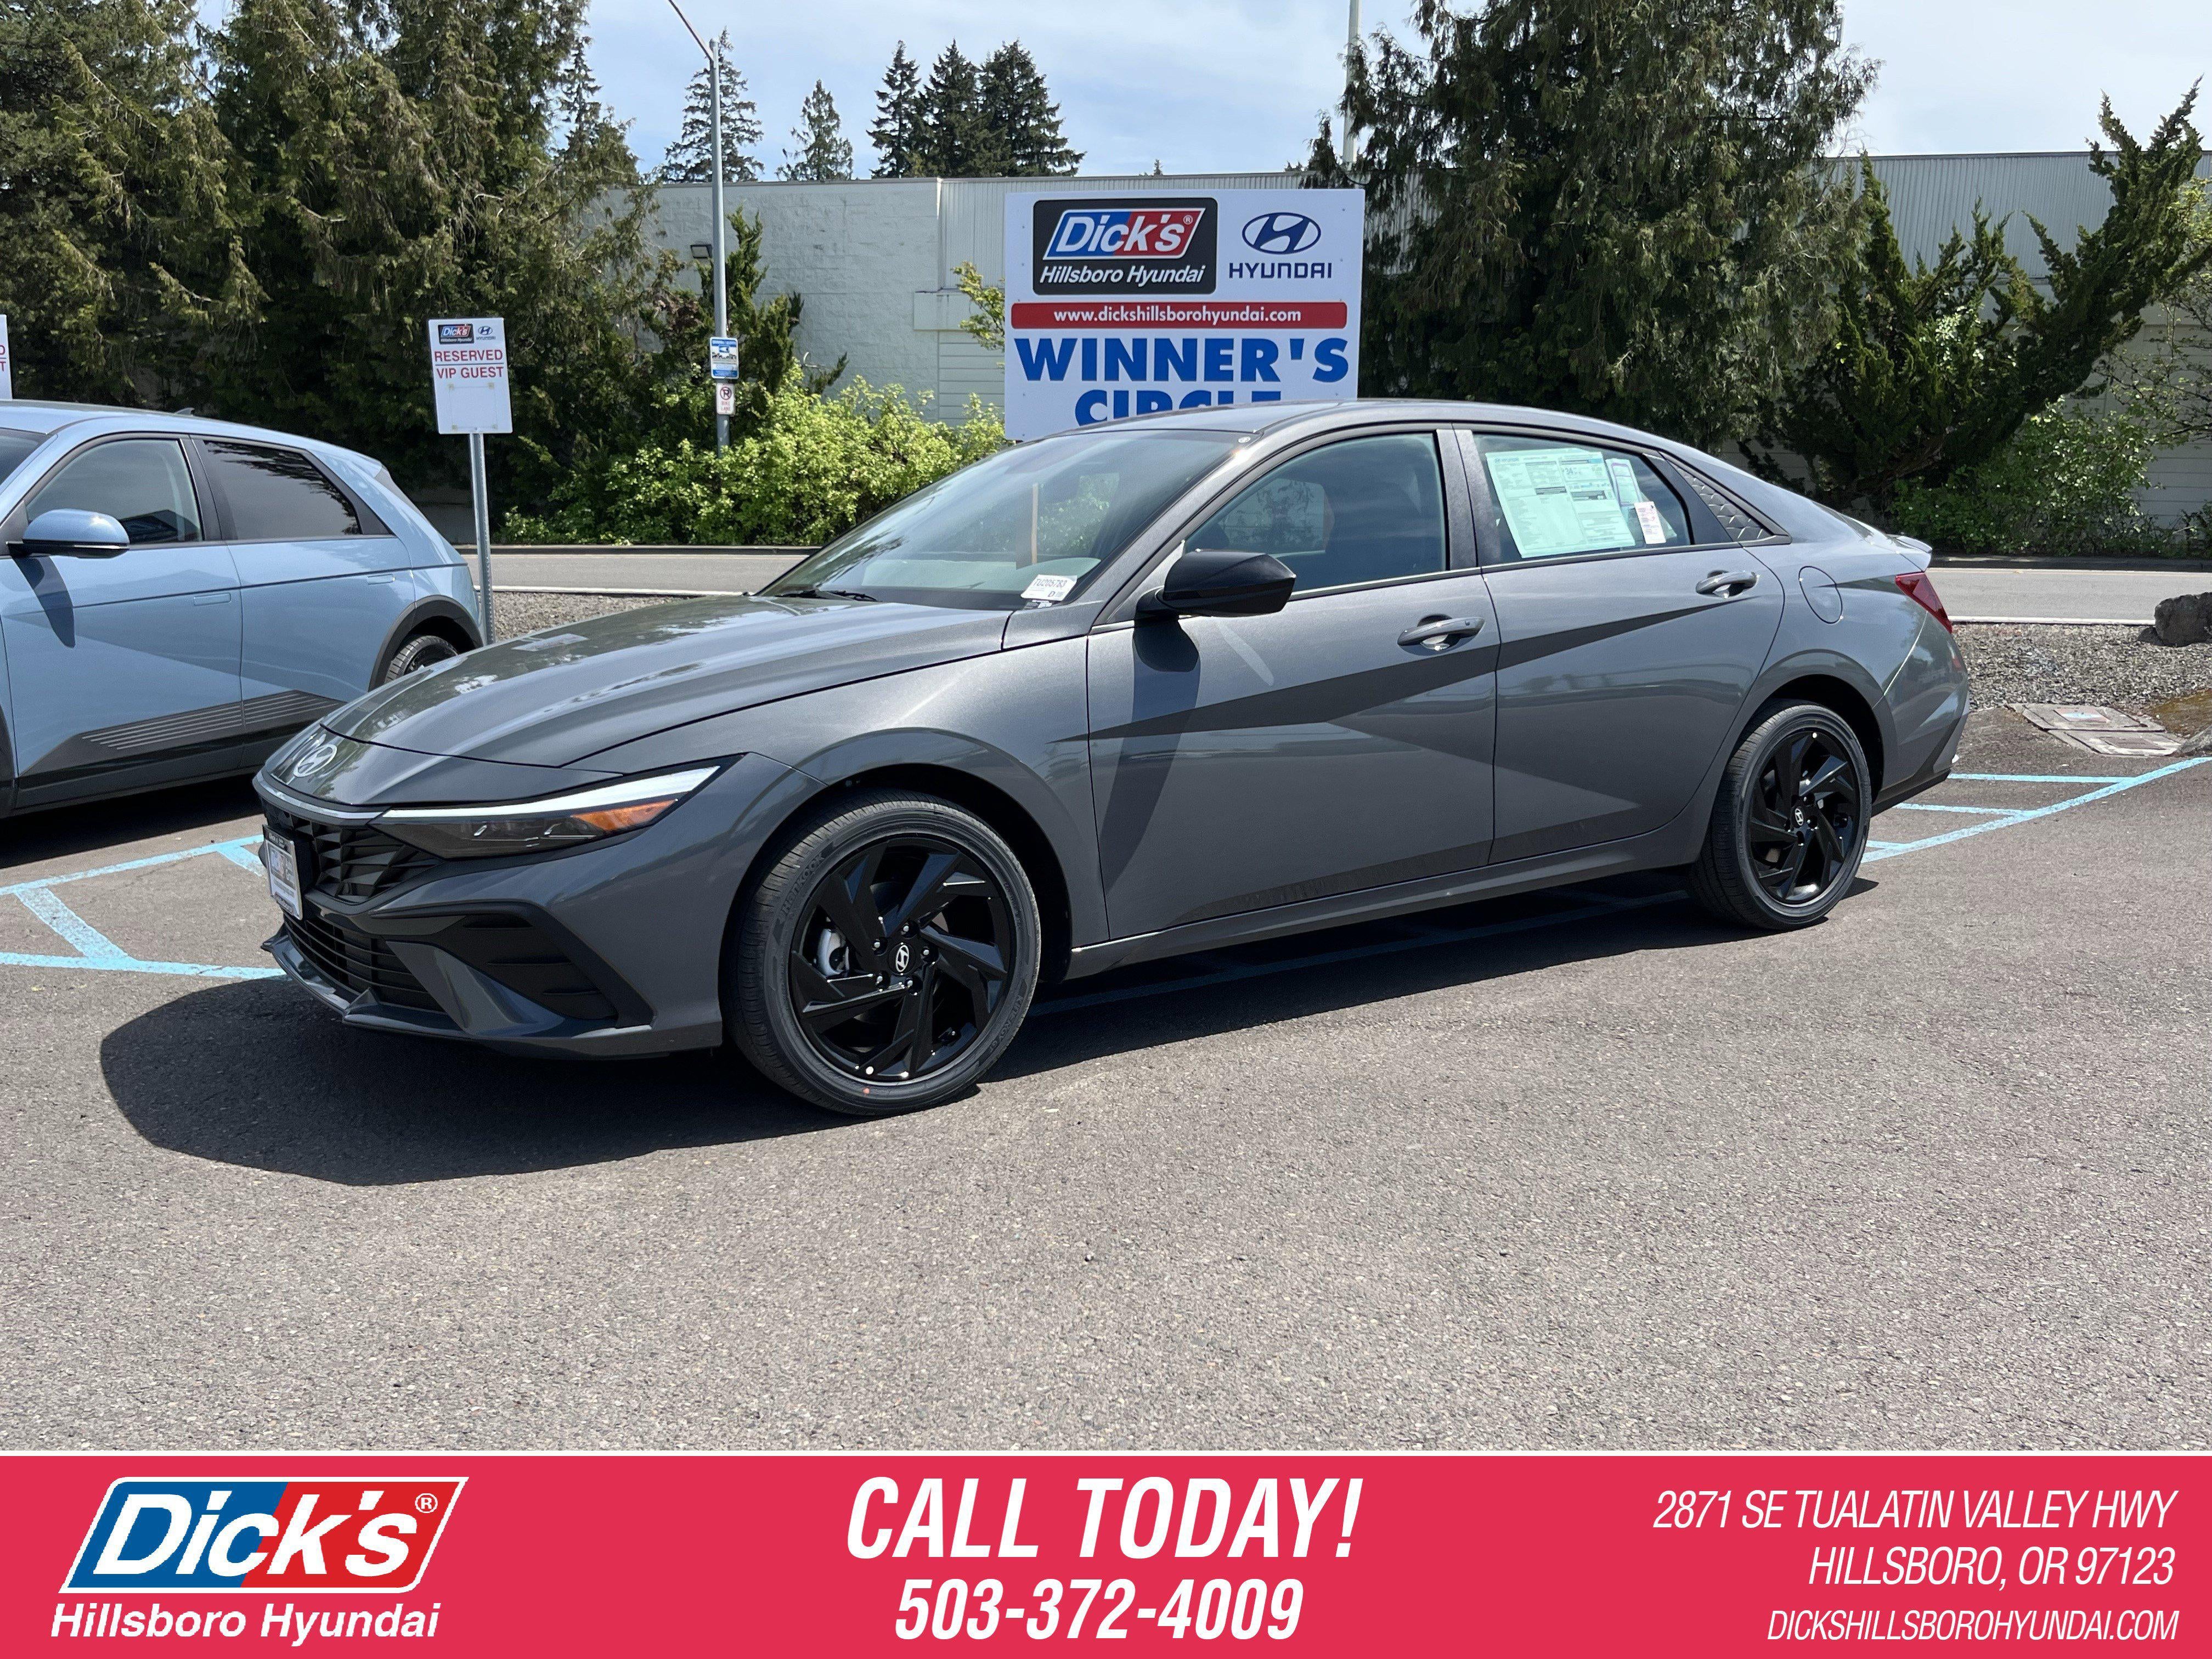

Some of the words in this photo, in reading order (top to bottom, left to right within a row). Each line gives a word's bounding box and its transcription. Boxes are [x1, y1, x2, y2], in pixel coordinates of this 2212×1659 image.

[1040, 264, 1123, 284] Hillsboro
[1126, 264, 1206, 288] Hyundai
[1228, 262, 1332, 279] HYUNDAI
[1054, 306, 1302, 326] www.dickshillsborohyundai.com
[434, 349, 503, 362] RESERVED
[1014, 337, 1349, 383] WINNER'S
[436, 367, 456, 379] VIP
[461, 366, 504, 379] GUEST
